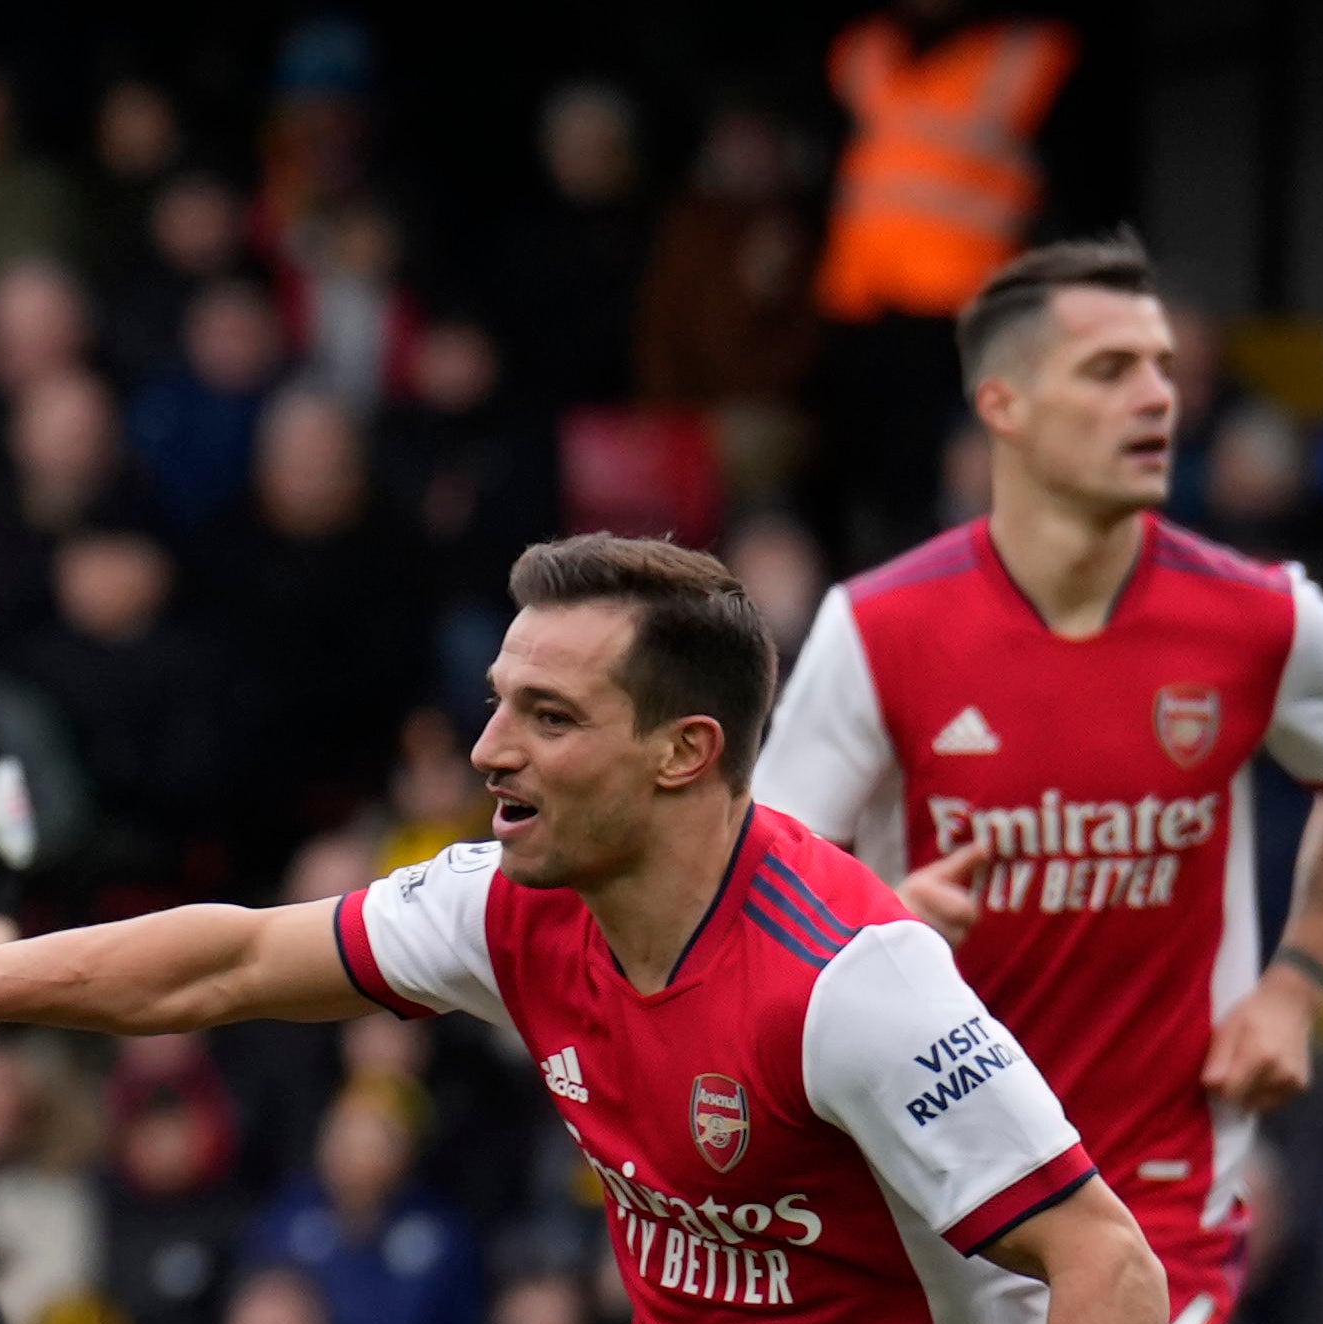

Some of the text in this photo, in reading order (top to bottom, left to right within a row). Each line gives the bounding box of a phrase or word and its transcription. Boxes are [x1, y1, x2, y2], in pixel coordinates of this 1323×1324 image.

[928, 787, 1222, 857] Emirates
[1039, 855, 1179, 915] BETTER
[913, 1016, 990, 1073] VISIT
[660, 1226, 794, 1305] BETTER
